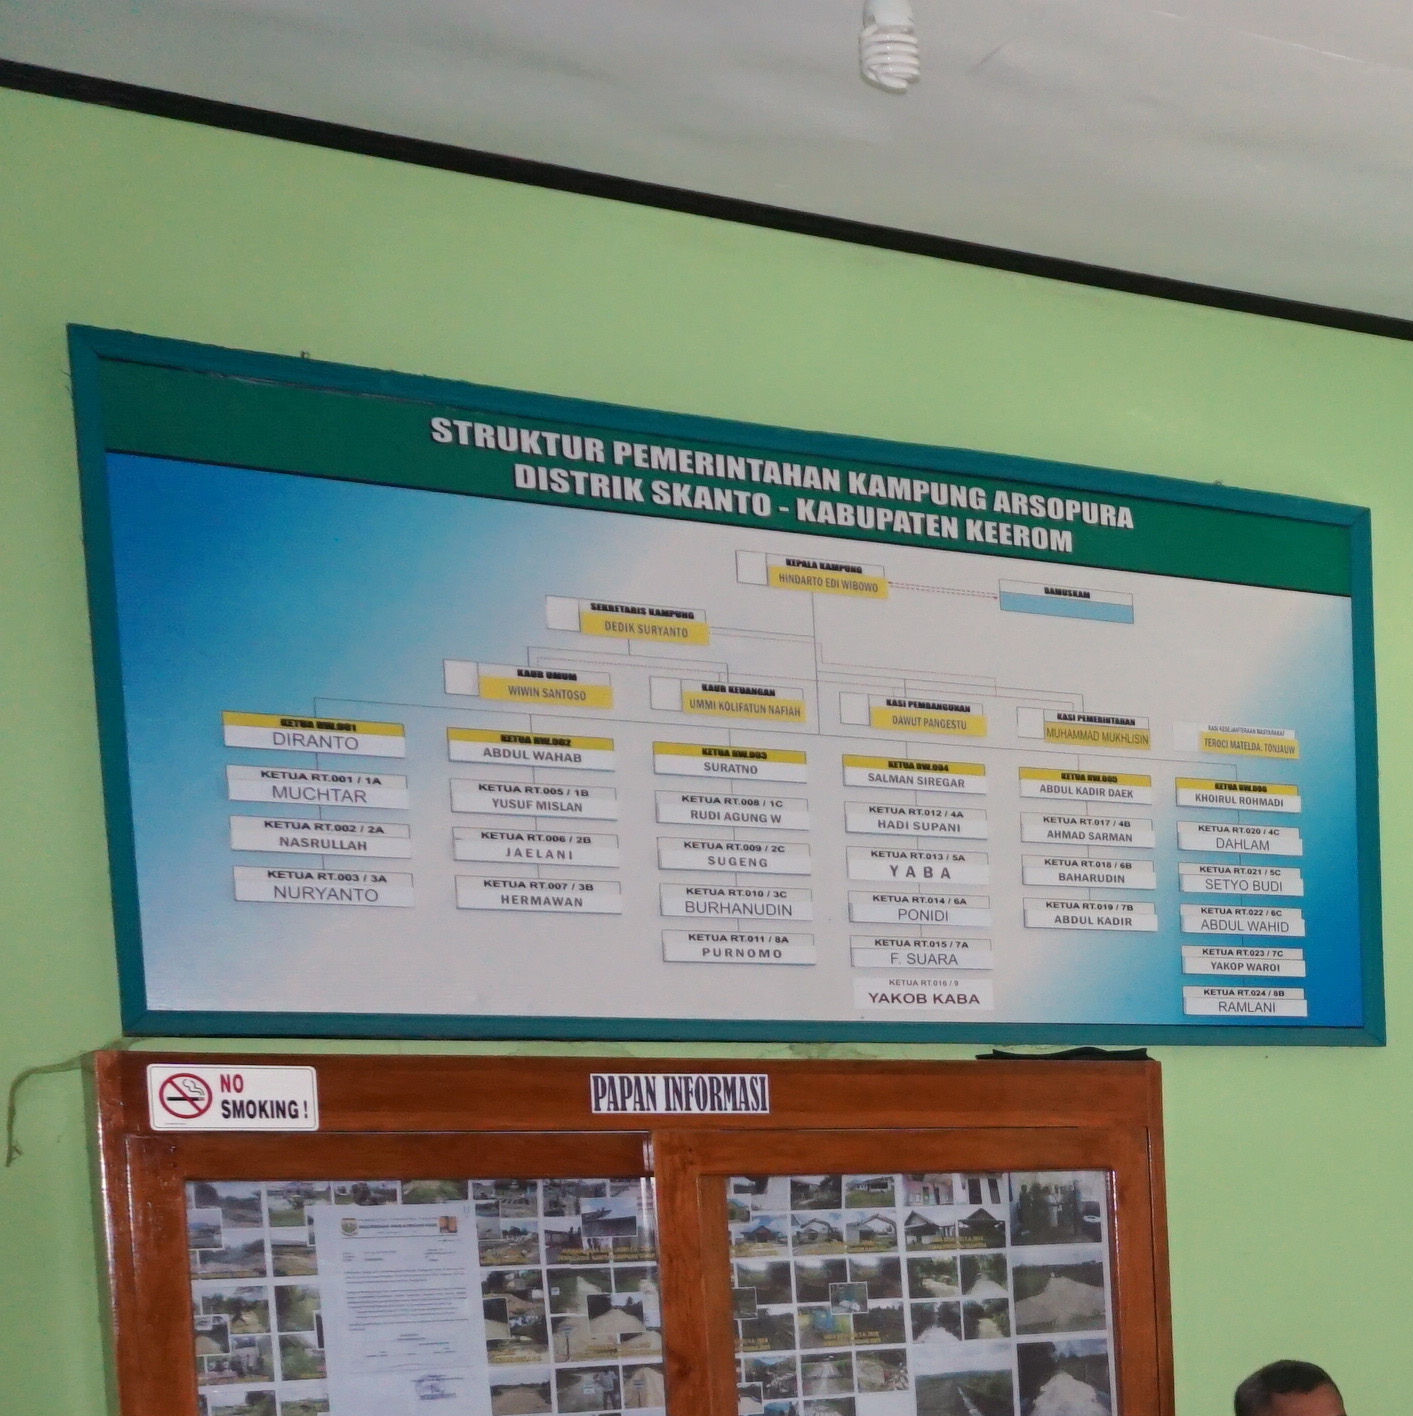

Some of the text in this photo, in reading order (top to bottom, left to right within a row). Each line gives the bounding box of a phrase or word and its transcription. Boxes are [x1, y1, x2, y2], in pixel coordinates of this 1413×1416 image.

[430, 416, 1134, 530] STRUKTUR PEMERINTAHAN KAMPUNG ARSOPURA
[514, 463, 1073, 554] DISTRIK SKANTO - KABUPATEN KEEROM
[785, 558, 862, 574] KEPALA KAMPUNG
[778, 573, 878, 593] HINDARTO EDI WIBOWO
[590, 602, 695, 620] SEKRETARIS KAMPUNG
[604, 620, 689, 639] DEDIK SURYANTO
[508, 684, 587, 702] WIWIN SANTOSO
[689, 699, 801, 718] UMMI KOLIFATUN NAFIAH
[892, 714, 967, 731] DAWUT PANGESTU
[273, 731, 359, 751] DIRANTO
[1046, 727, 1149, 746] MUHAMMAD MUKHLISIN
[483, 747, 582, 763] ABDUL WAHAB
[703, 761, 758, 775] SURATNO
[260, 770, 310, 781] KETUA
[311, 773, 353, 784] RT.001
[365, 776, 383, 786] 1A
[867, 773, 965, 789] SALMAN SIREGAR
[272, 785, 367, 804] MUCHTAR
[478, 783, 522, 794] KETUA
[575, 789, 589, 797] 1B
[1039, 784, 1134, 798] ABDUL KADIR DAEK
[491, 798, 583, 813] YUSUF MISLAN
[681, 795, 721, 805] KETUA
[770, 800, 784, 808] 1C
[1195, 793, 1284, 807] KHOIRUL ROHMADI
[690, 810, 782, 824] RUDI AGUNG W
[869, 806, 906, 815] KETUA
[908, 808, 943, 817] RT.012
[950, 810, 964, 818] 4A
[877, 819, 961, 833] HADI SUPANI
[1043, 816, 1077, 825] KETUA
[1079, 818, 1111, 827] RT.017
[1119, 820, 1131, 828] 4B
[1046, 830, 1133, 842] AHMAD SARMAN
[1198, 825, 1229, 833] KETUA
[1231, 826, 1261, 835] RT.020
[1268, 828, 1280, 836] 4C
[279, 836, 367, 851] NASRULLAH
[1216, 837, 1270, 851] DAHLAM
[707, 855, 768, 868] SUGENG
[1058, 872, 1126, 884] BAHARUDIN
[1205, 878, 1283, 893] SETYO BUDI
[273, 885, 379, 903] NURYANTO
[501, 894, 584, 908] HERMAWAN
[685, 901, 793, 917] BURHANUDIN
[898, 908, 949, 922] PONIDI
[1054, 915, 1133, 927] ABDUL KADIR
[1200, 919, 1289, 933] ABDUL WAHID
[702, 947, 782, 959] PURNOMO
[890, 953, 958, 966] F. SUARA
[1210, 960, 1280, 972] YAKOP WAROI
[868, 992, 980, 1005] YAKOB KABA
[1218, 1001, 1276, 1014] RAMLANI
[220, 1074, 244, 1093] NO
[592, 1075, 768, 1112] PAPAN INFORMASI
